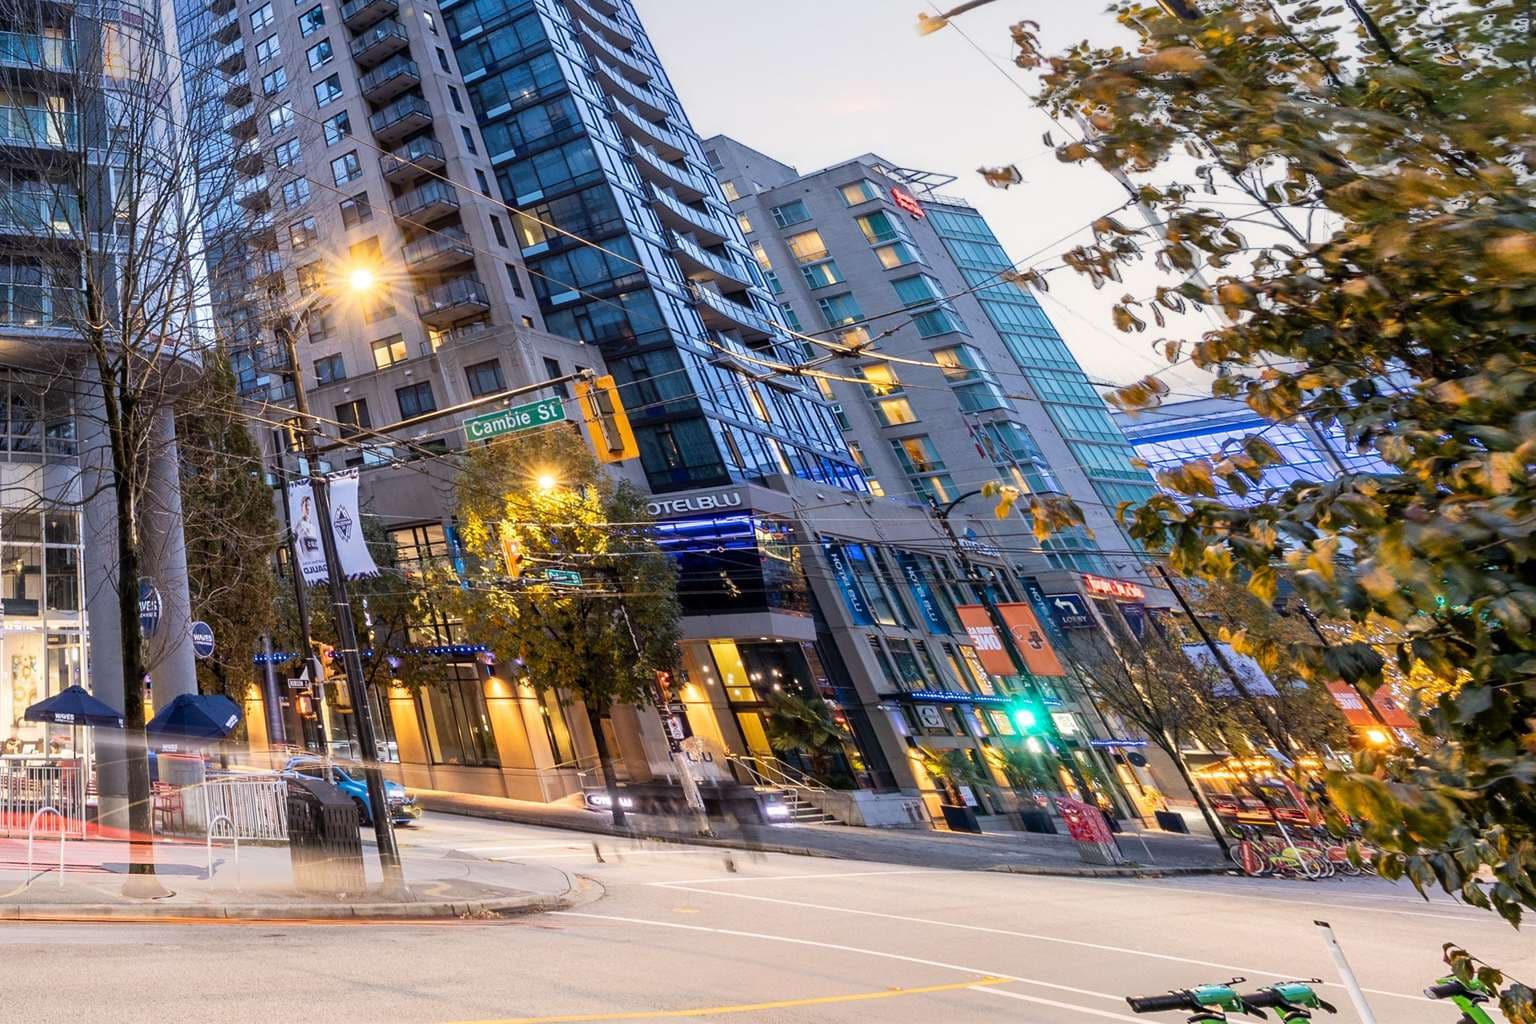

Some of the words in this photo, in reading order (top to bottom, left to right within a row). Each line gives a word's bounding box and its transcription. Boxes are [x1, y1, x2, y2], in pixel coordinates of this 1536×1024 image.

[471, 412, 531, 436] Cambie
[537, 400, 558, 420] St
[646, 492, 742, 516] OTELBLU
[846, 588, 863, 613] BLU
[193, 633, 213, 642] WAVES
[54, 712, 75, 721] WAVES
